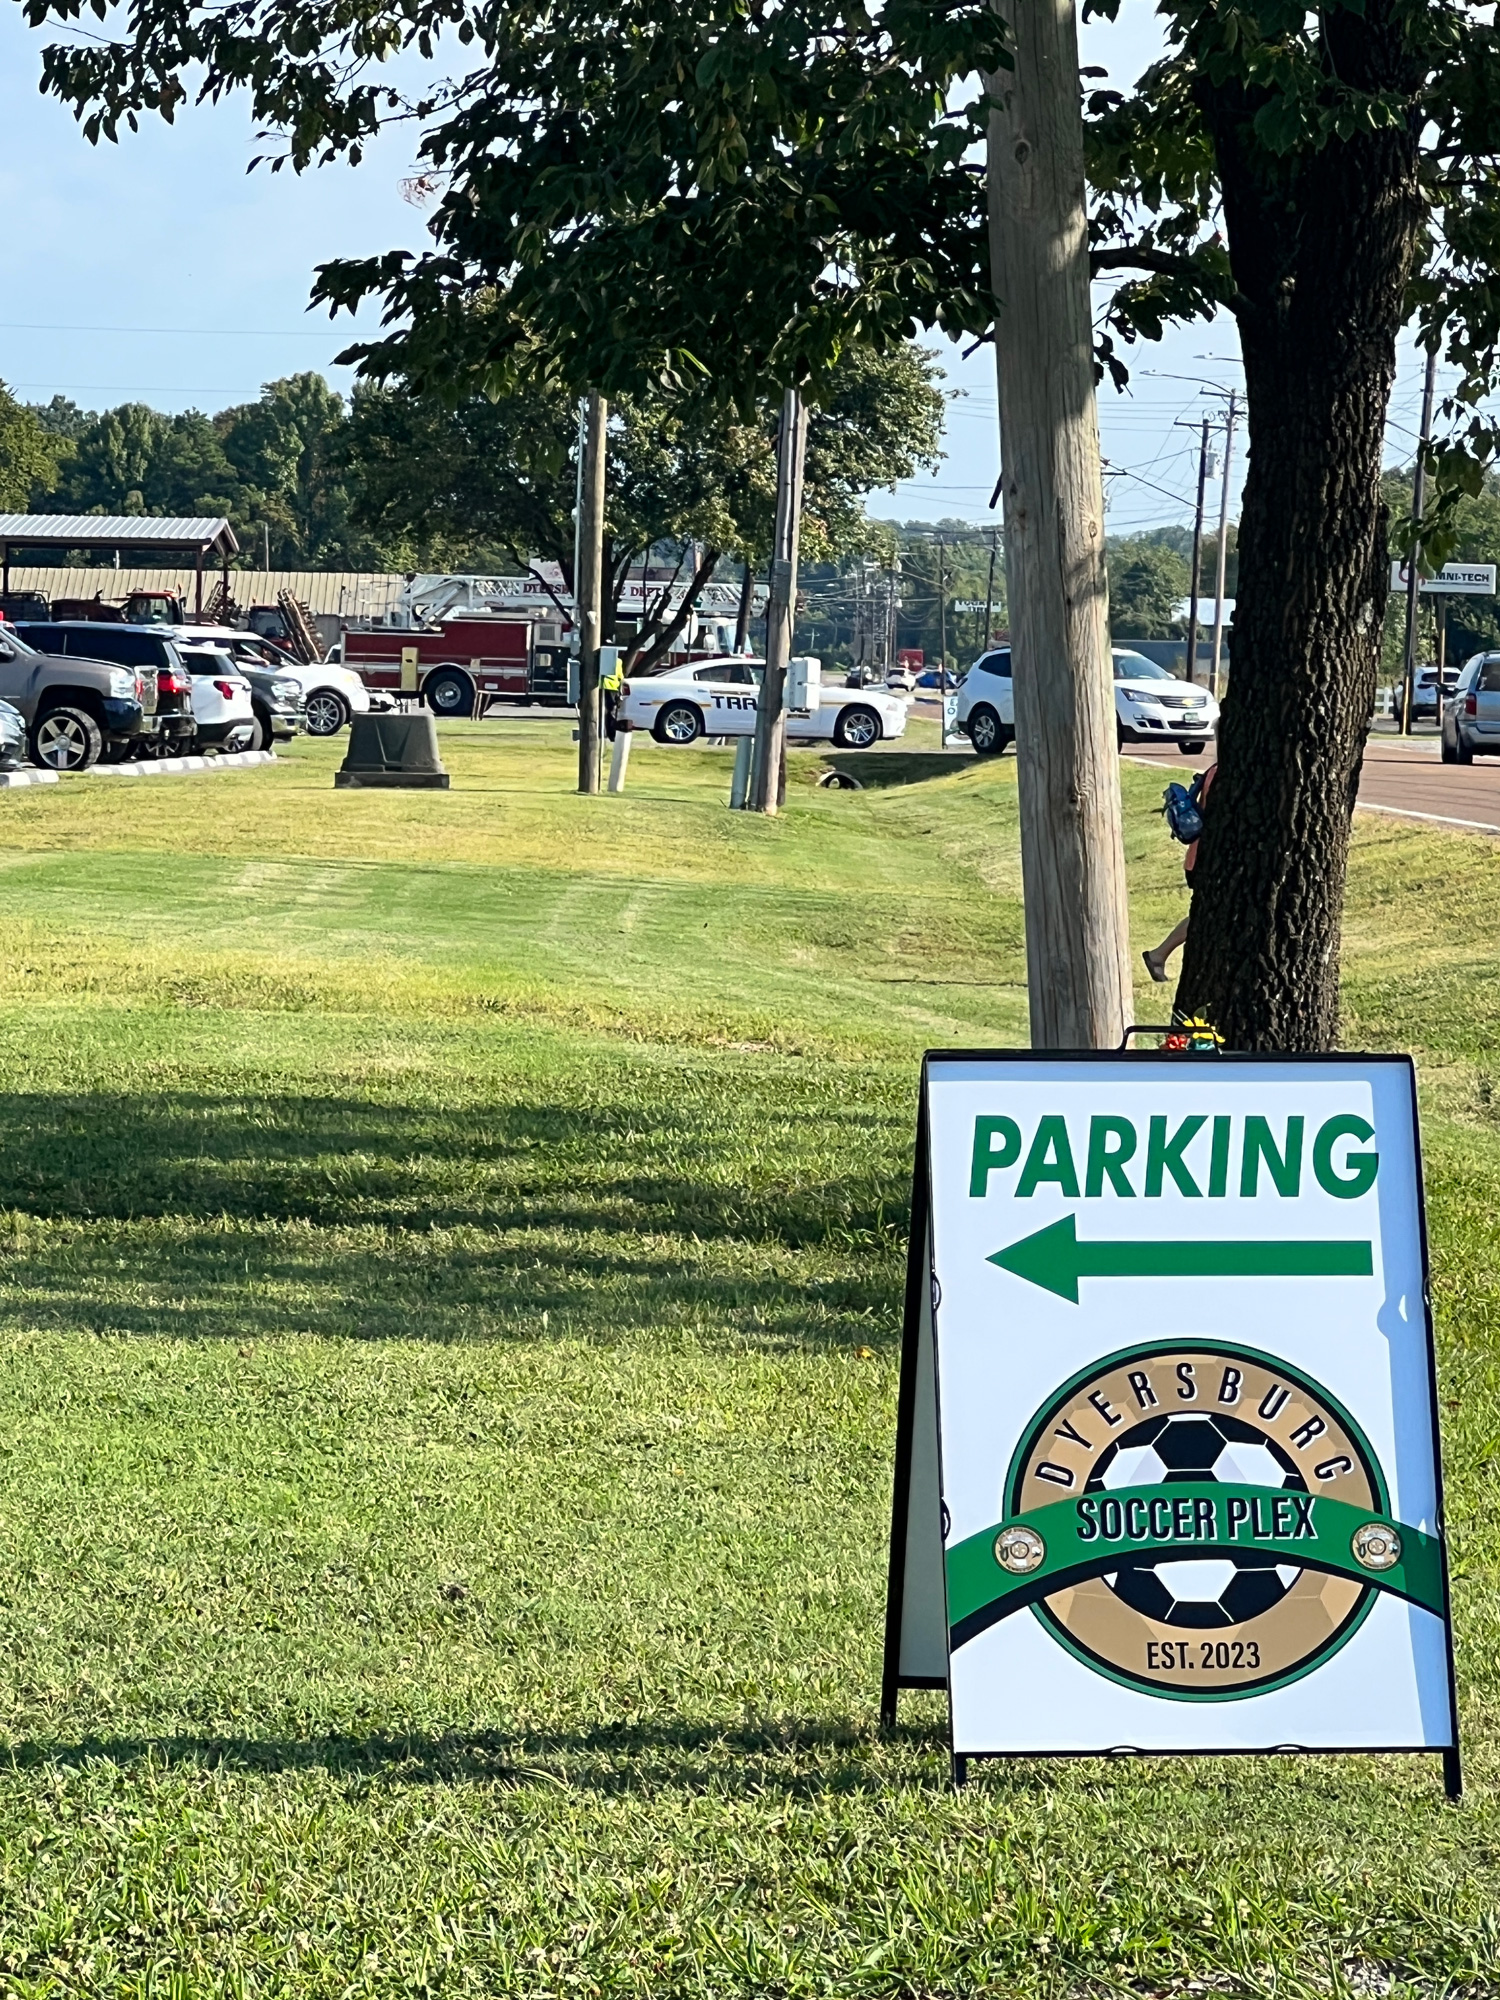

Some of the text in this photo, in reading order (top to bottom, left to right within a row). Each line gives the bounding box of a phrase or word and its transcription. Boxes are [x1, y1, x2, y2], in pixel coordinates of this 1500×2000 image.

[1435, 572, 1490, 582] MNI-TECH
[968, 1113, 1380, 1200] PARKING
[1034, 1361, 1355, 1488] DYERSBURG
[1076, 1496, 1319, 1541] SOCCER PLEX
[1146, 1641, 1261, 1670] EST. 2023
